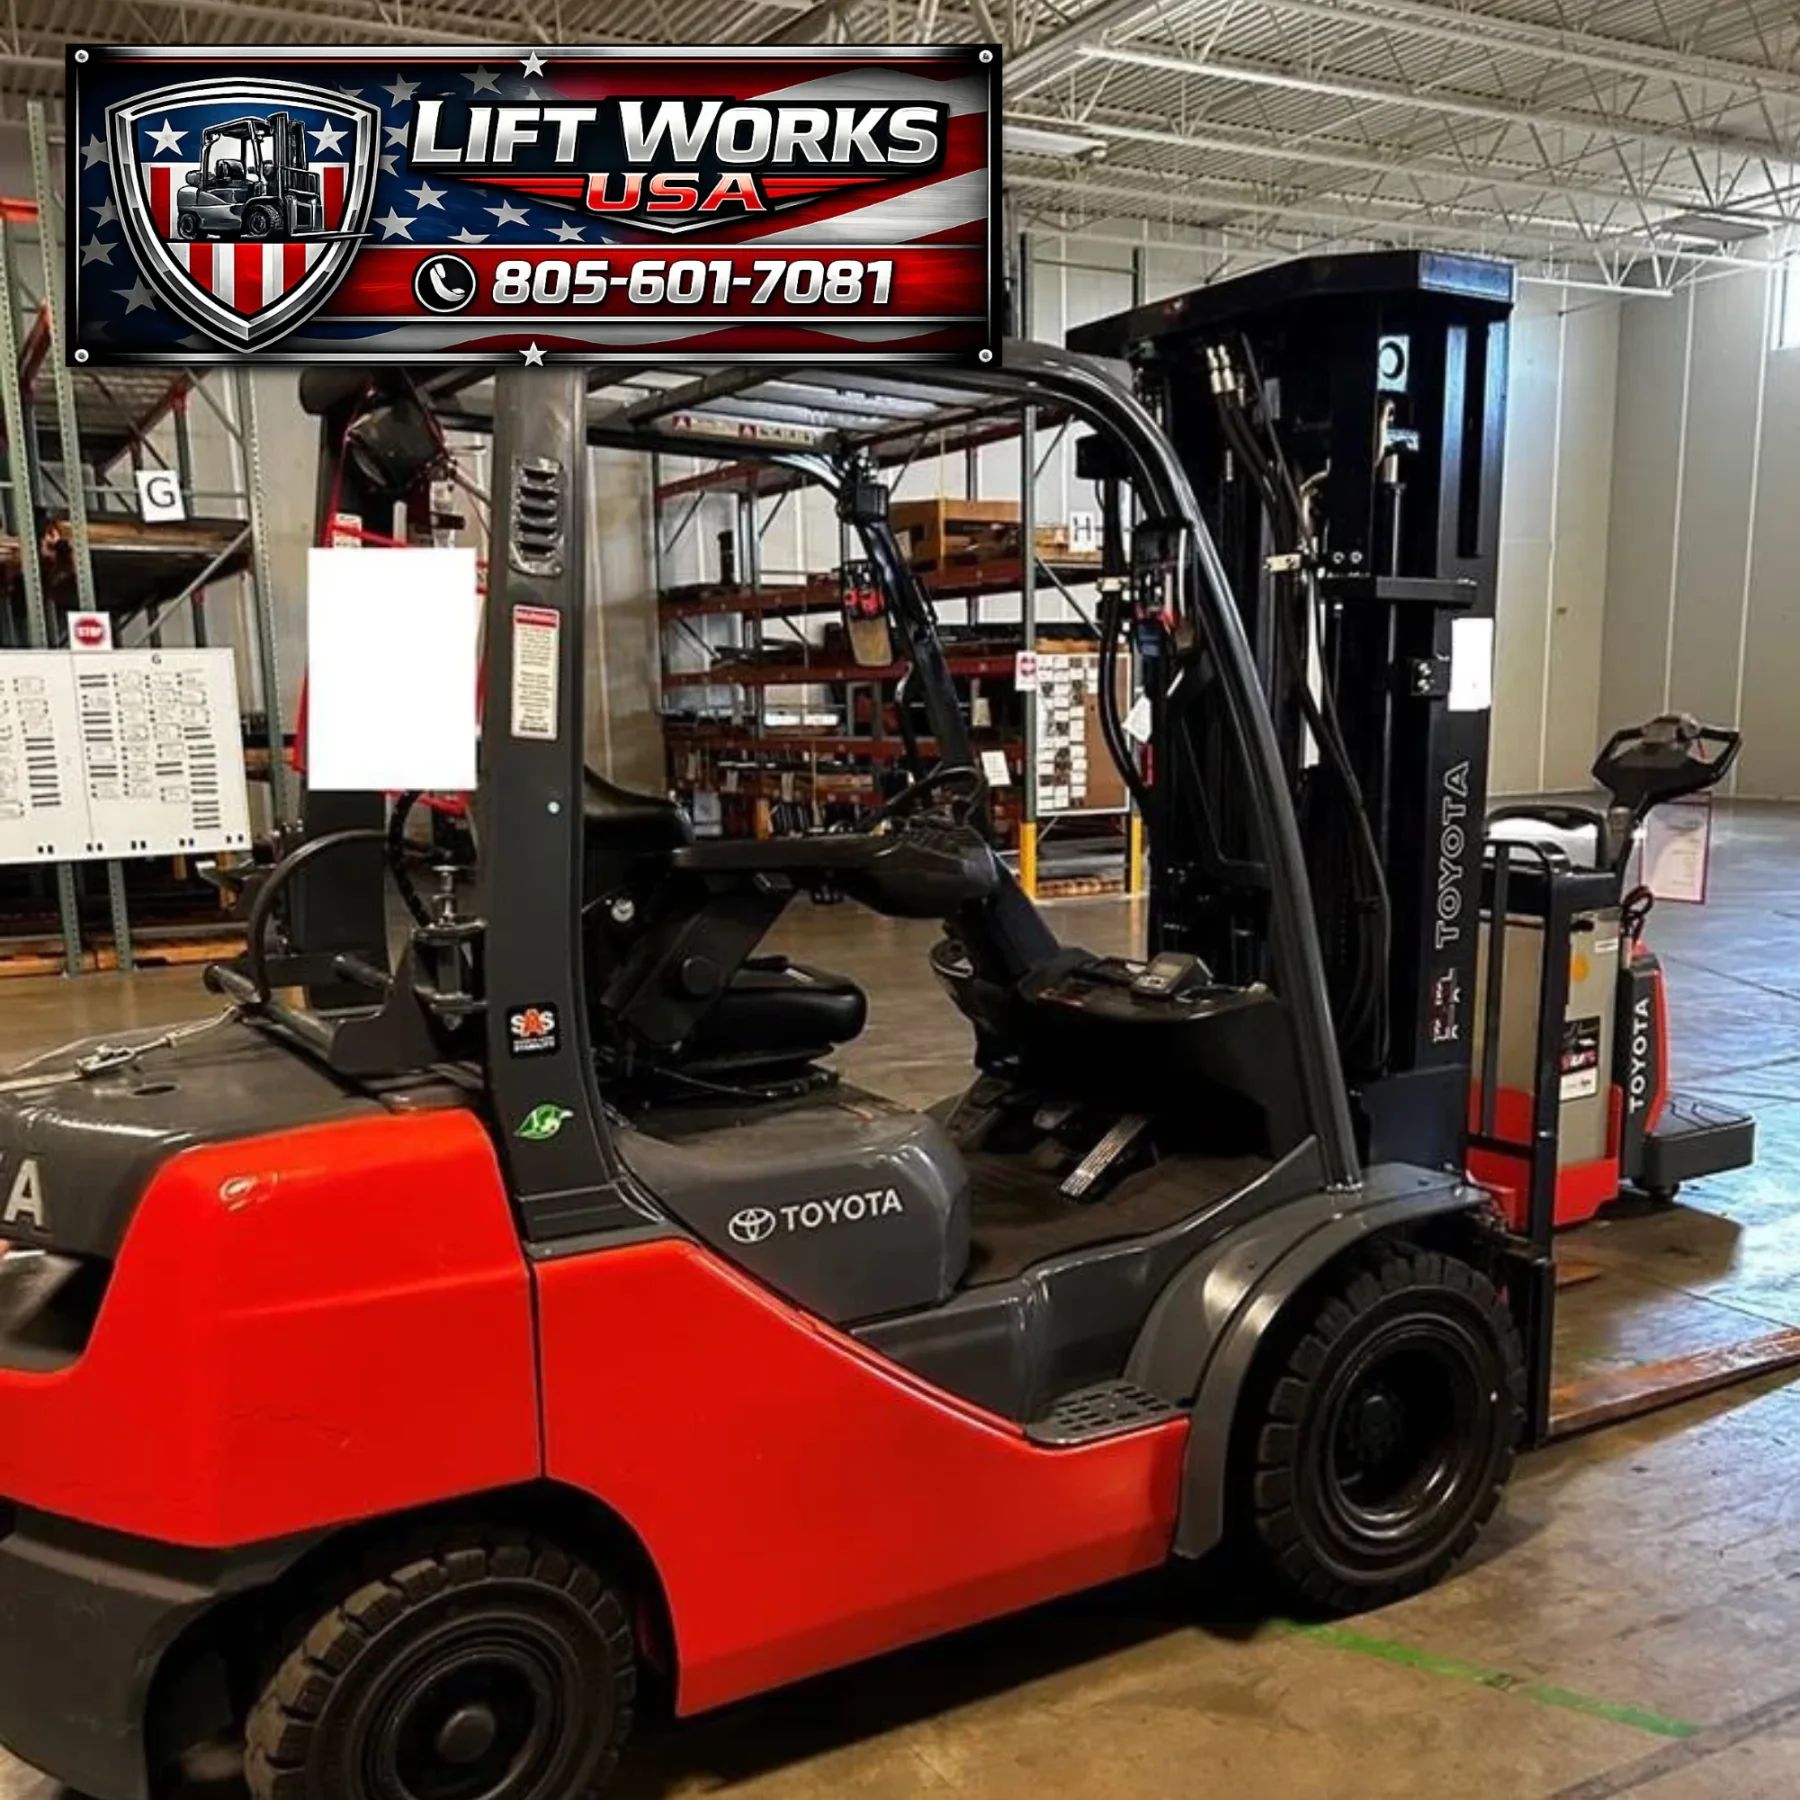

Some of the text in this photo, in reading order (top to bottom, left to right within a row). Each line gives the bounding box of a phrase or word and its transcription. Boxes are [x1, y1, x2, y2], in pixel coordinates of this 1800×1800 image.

[146, 476, 176, 508] G
[1072, 515, 1092, 542] H
[1435, 760, 1469, 949] TOYOTA
[510, 1008, 555, 1037] SAS
[1628, 997, 1650, 1114] TOYOTA
[0, 1151, 44, 1226] A
[780, 1188, 903, 1232] TOYOTA
